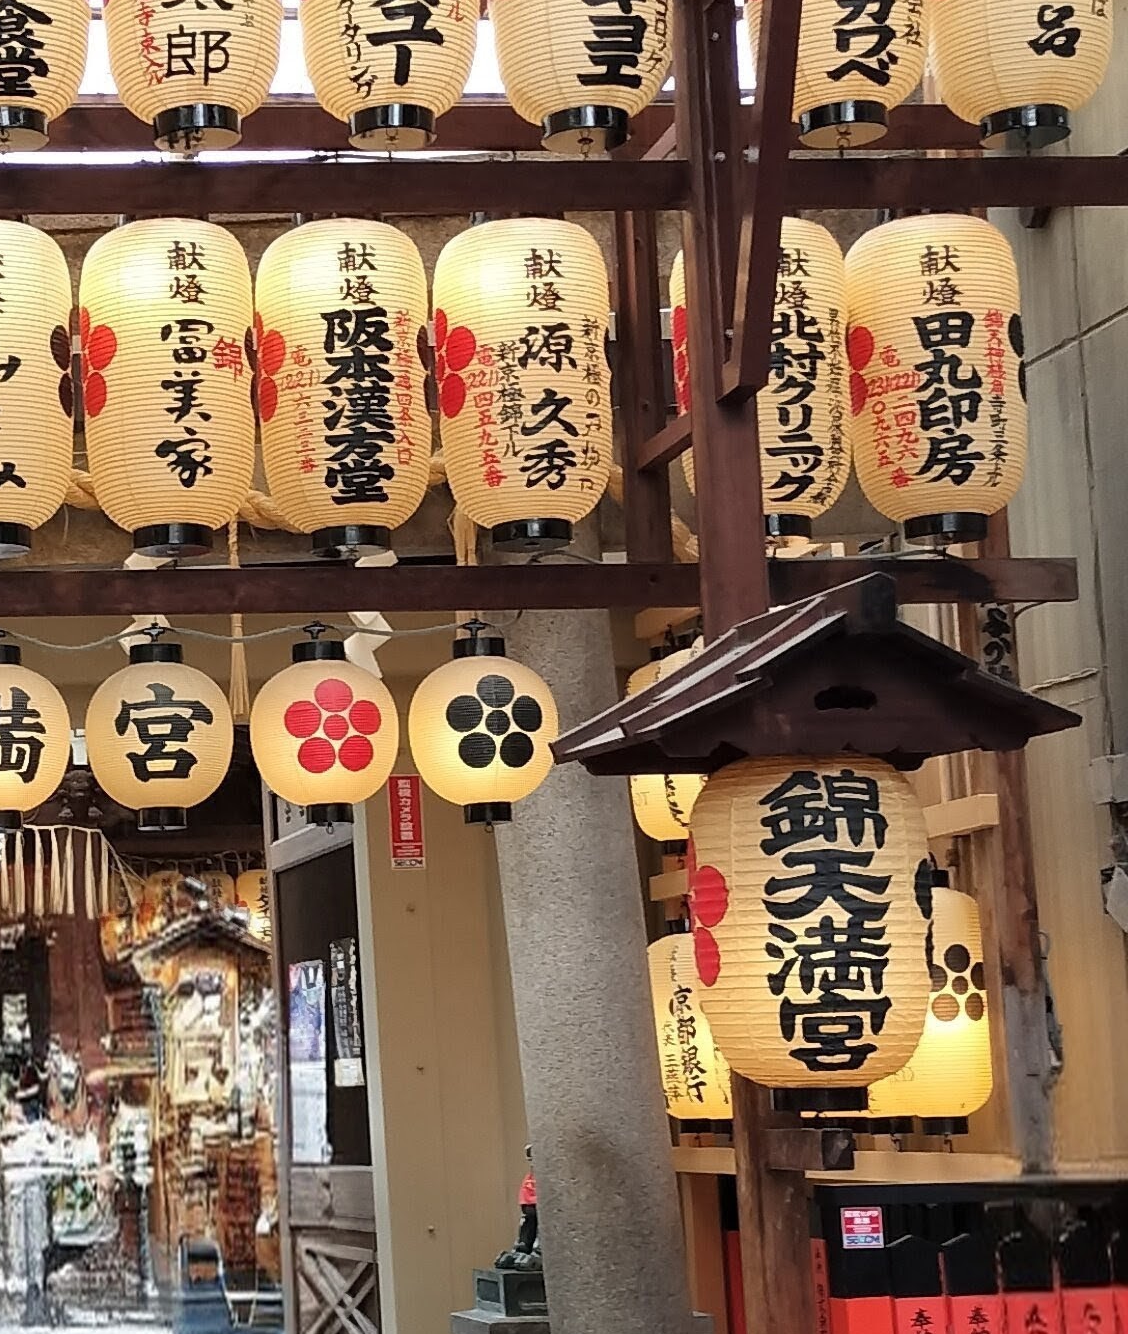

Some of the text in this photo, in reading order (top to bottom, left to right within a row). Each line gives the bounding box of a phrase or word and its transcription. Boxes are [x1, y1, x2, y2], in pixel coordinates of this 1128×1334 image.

[167, 241, 208, 305] 献燈
[338, 242, 380, 306] 献燈
[524, 248, 565, 312] 献燈
[920, 245, 962, 306] 献燈
[212, 337, 244, 382] 錦
[320, 306, 395, 506] 阪本漢方堂
[518, 323, 579, 490] 源久秀
[765, 310, 825, 503] 北村クリニック
[912, 311, 985, 486] 田丸印房
[115, 684, 213, 782] 宮
[759, 769, 892, 1072] 錦天満宮
